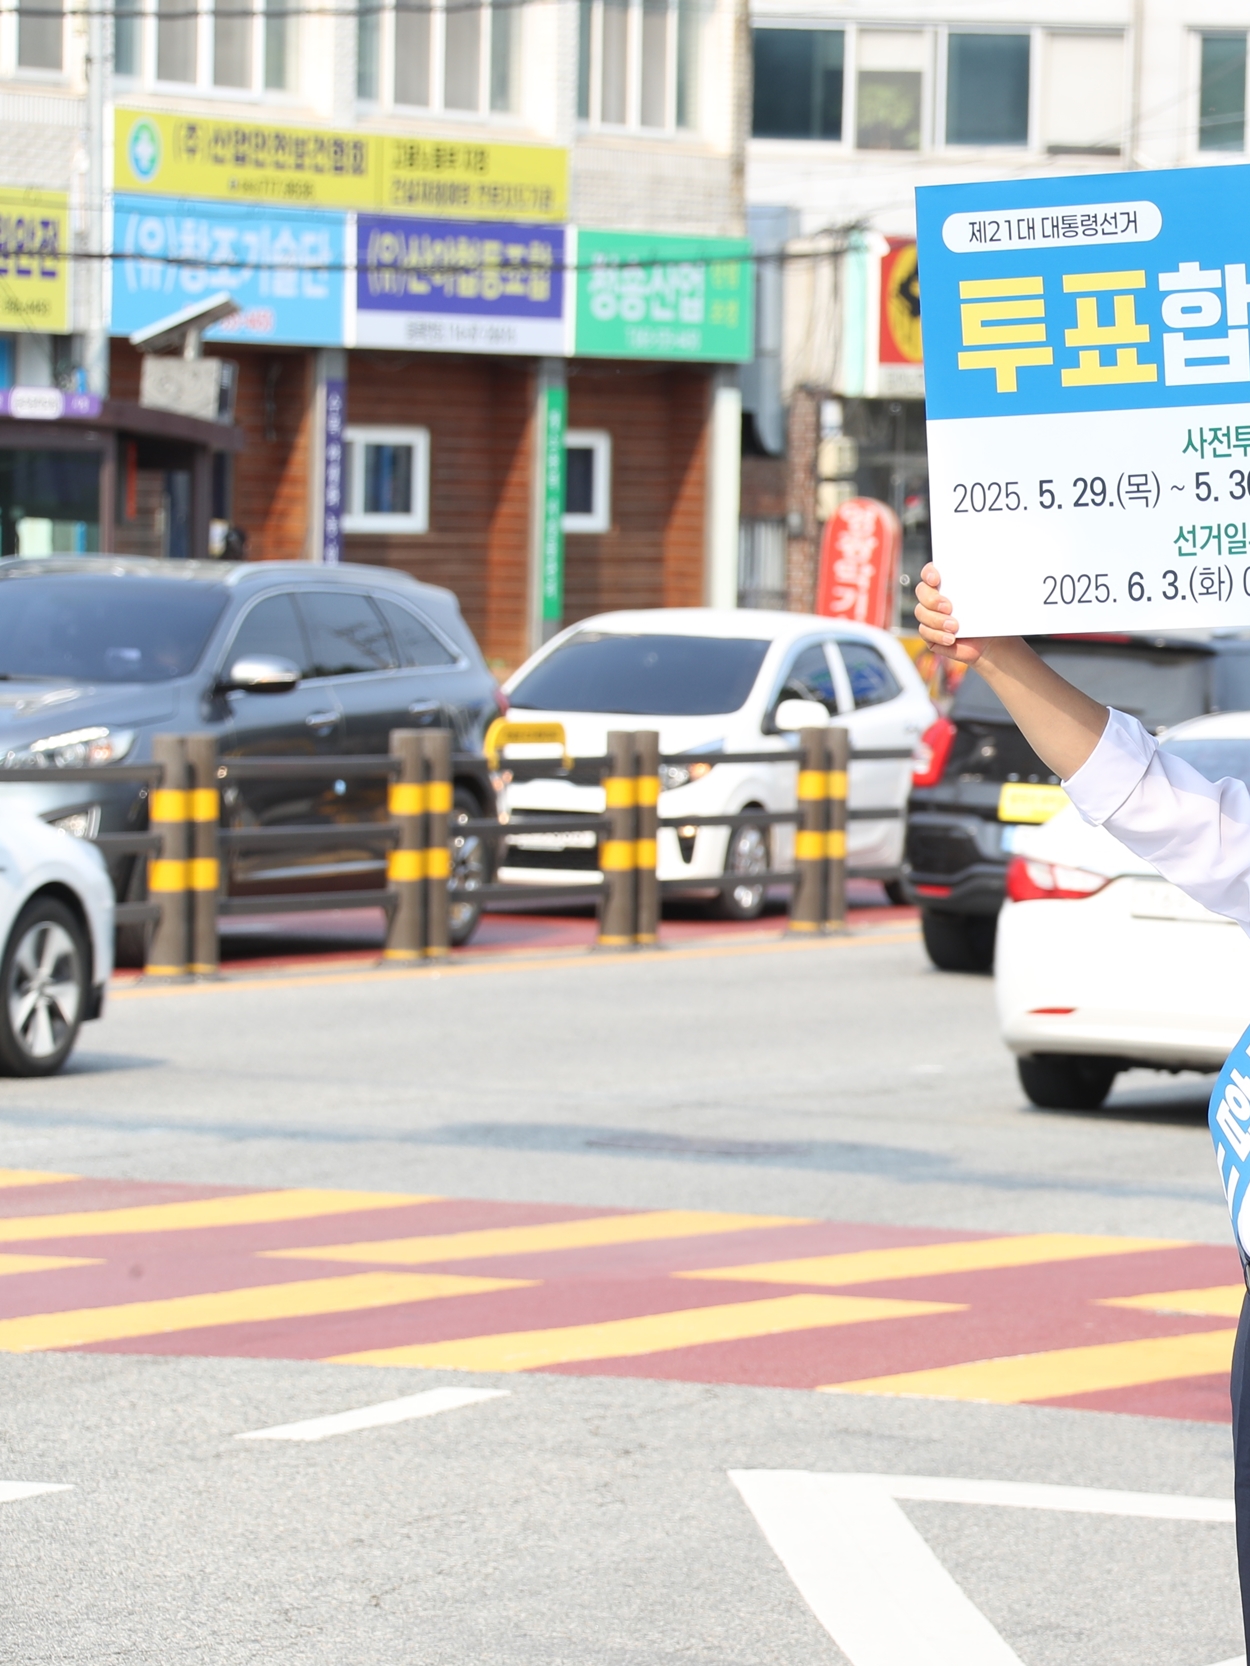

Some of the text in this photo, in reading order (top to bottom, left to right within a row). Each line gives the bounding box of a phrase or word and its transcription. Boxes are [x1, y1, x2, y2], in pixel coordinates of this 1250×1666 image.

[968, 210, 1138, 244] 제21대 대통령선거
[953, 481, 1028, 513] 2025.
[1039, 479, 1063, 509] 5.
[1072, 470, 1160, 510] 29.(목)
[1195, 471, 1219, 502] 5.
[1043, 573, 1117, 605] 2025.
[1127, 571, 1152, 602] 6.
[1162, 564, 1233, 603] 3.(화)
